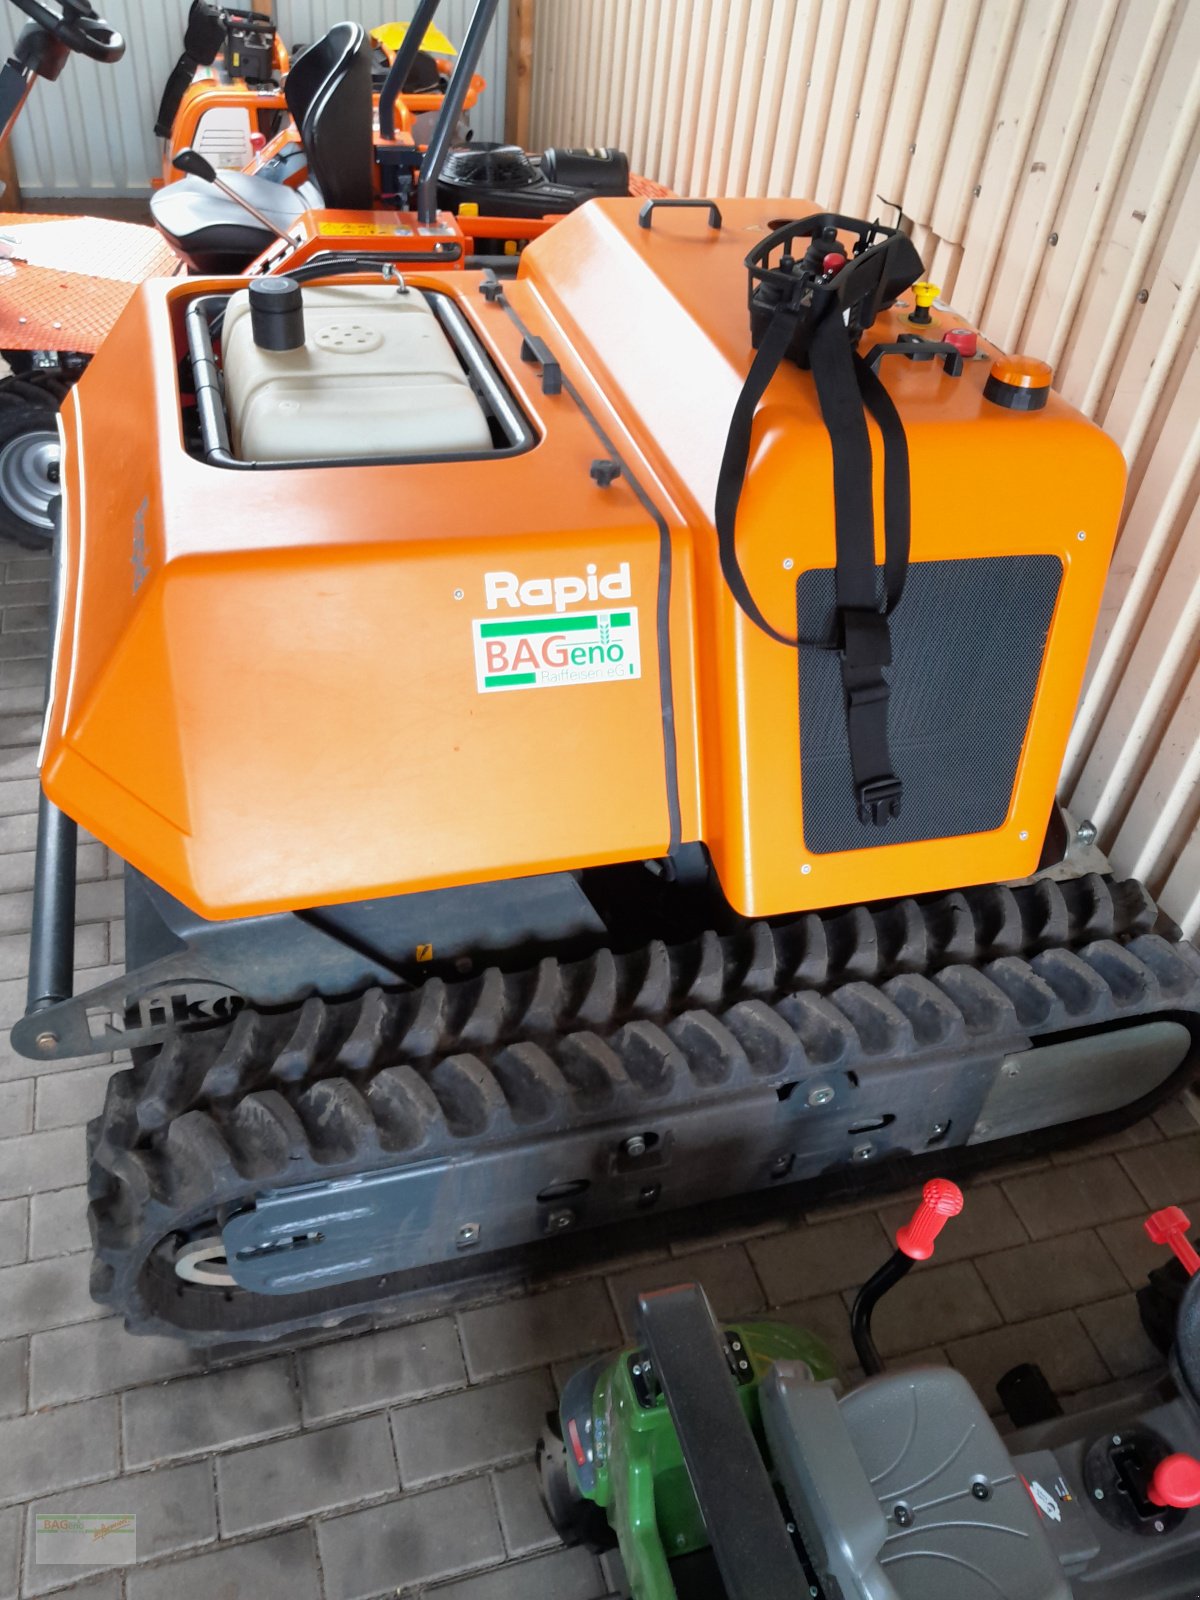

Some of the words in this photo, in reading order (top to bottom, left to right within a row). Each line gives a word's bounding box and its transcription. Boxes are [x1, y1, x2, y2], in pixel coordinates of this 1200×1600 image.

[484, 562, 631, 612] Rapid
[486, 636, 624, 673] BAGeno
[541, 667, 603, 682] Raiffeisen
[607, 664, 625, 677] eG
